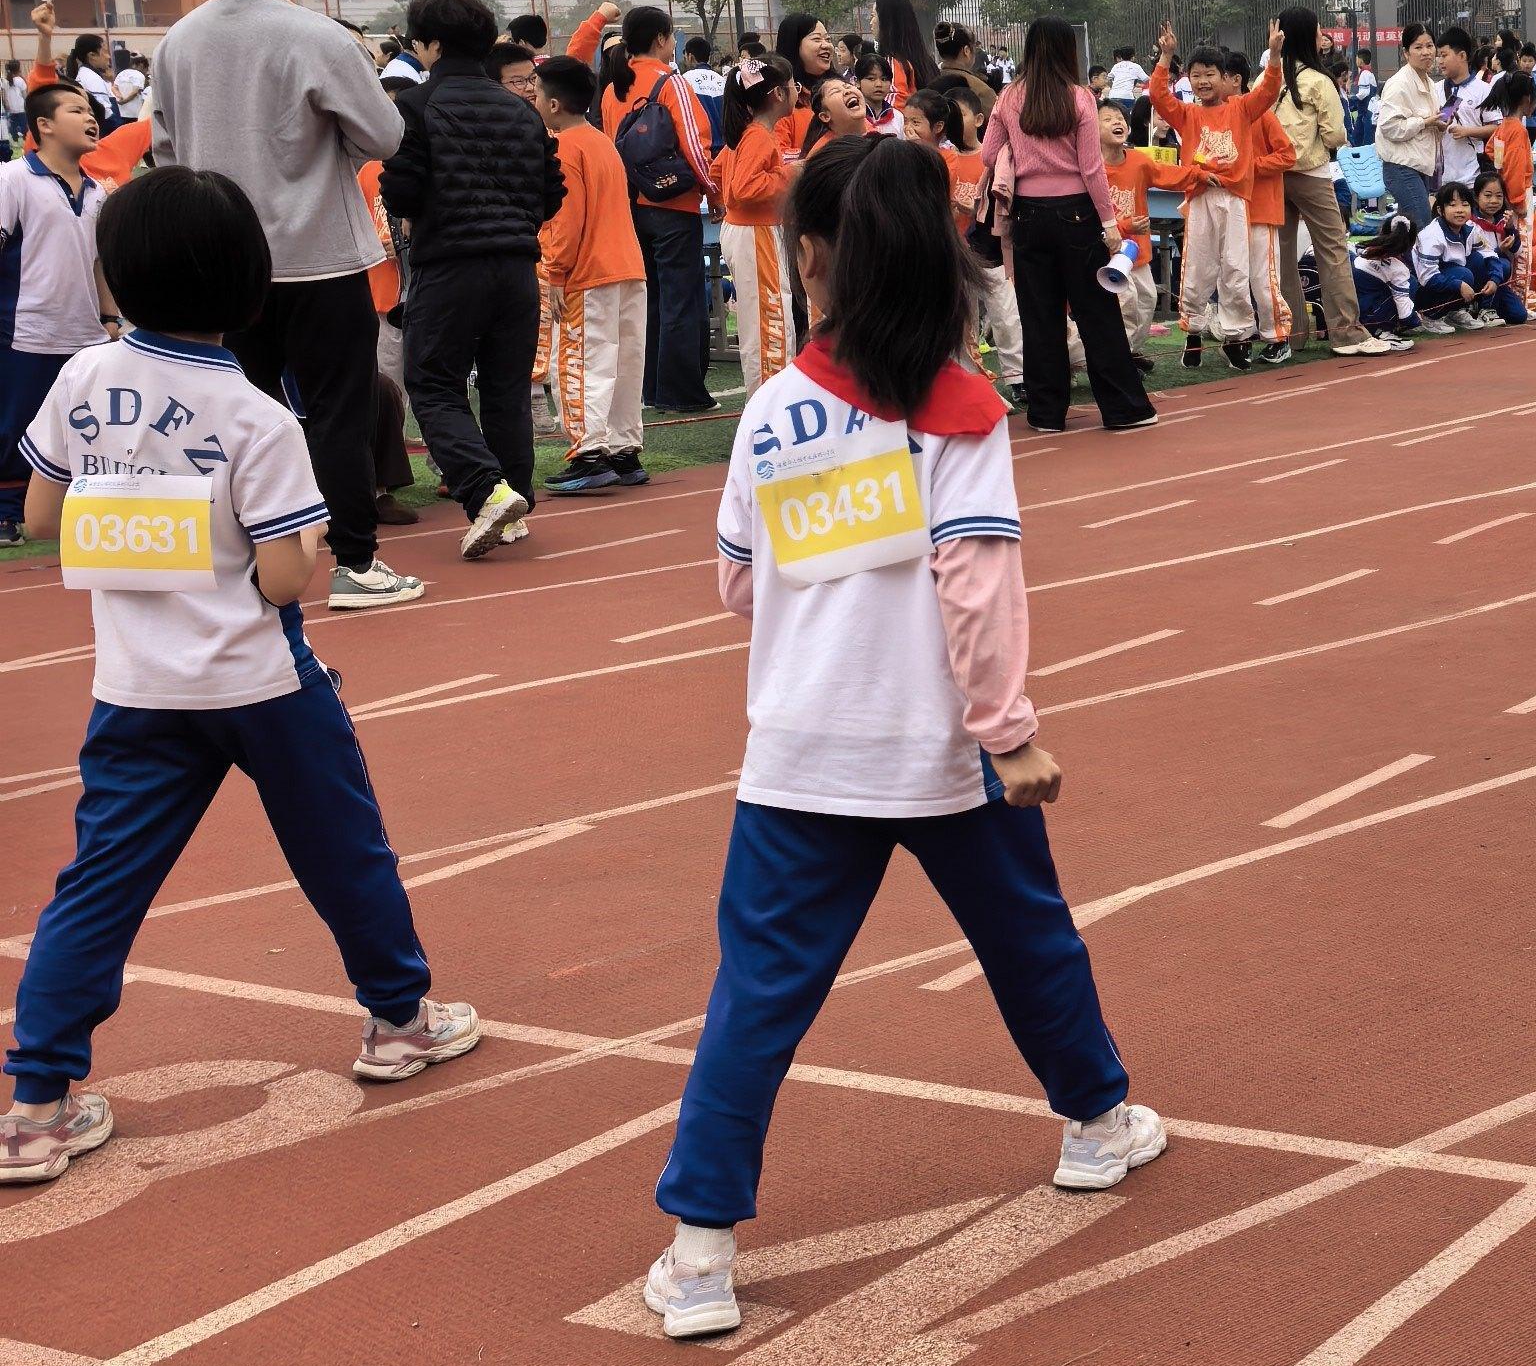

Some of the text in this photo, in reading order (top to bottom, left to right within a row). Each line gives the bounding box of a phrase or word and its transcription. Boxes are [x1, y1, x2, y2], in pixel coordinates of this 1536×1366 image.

[766, 286, 784, 372] TWALK
[566, 321, 583, 435] ATWALK
[68, 387, 229, 475] SDFZ
[75, 513, 200, 554] 03631
[780, 470, 906, 541] 03431
